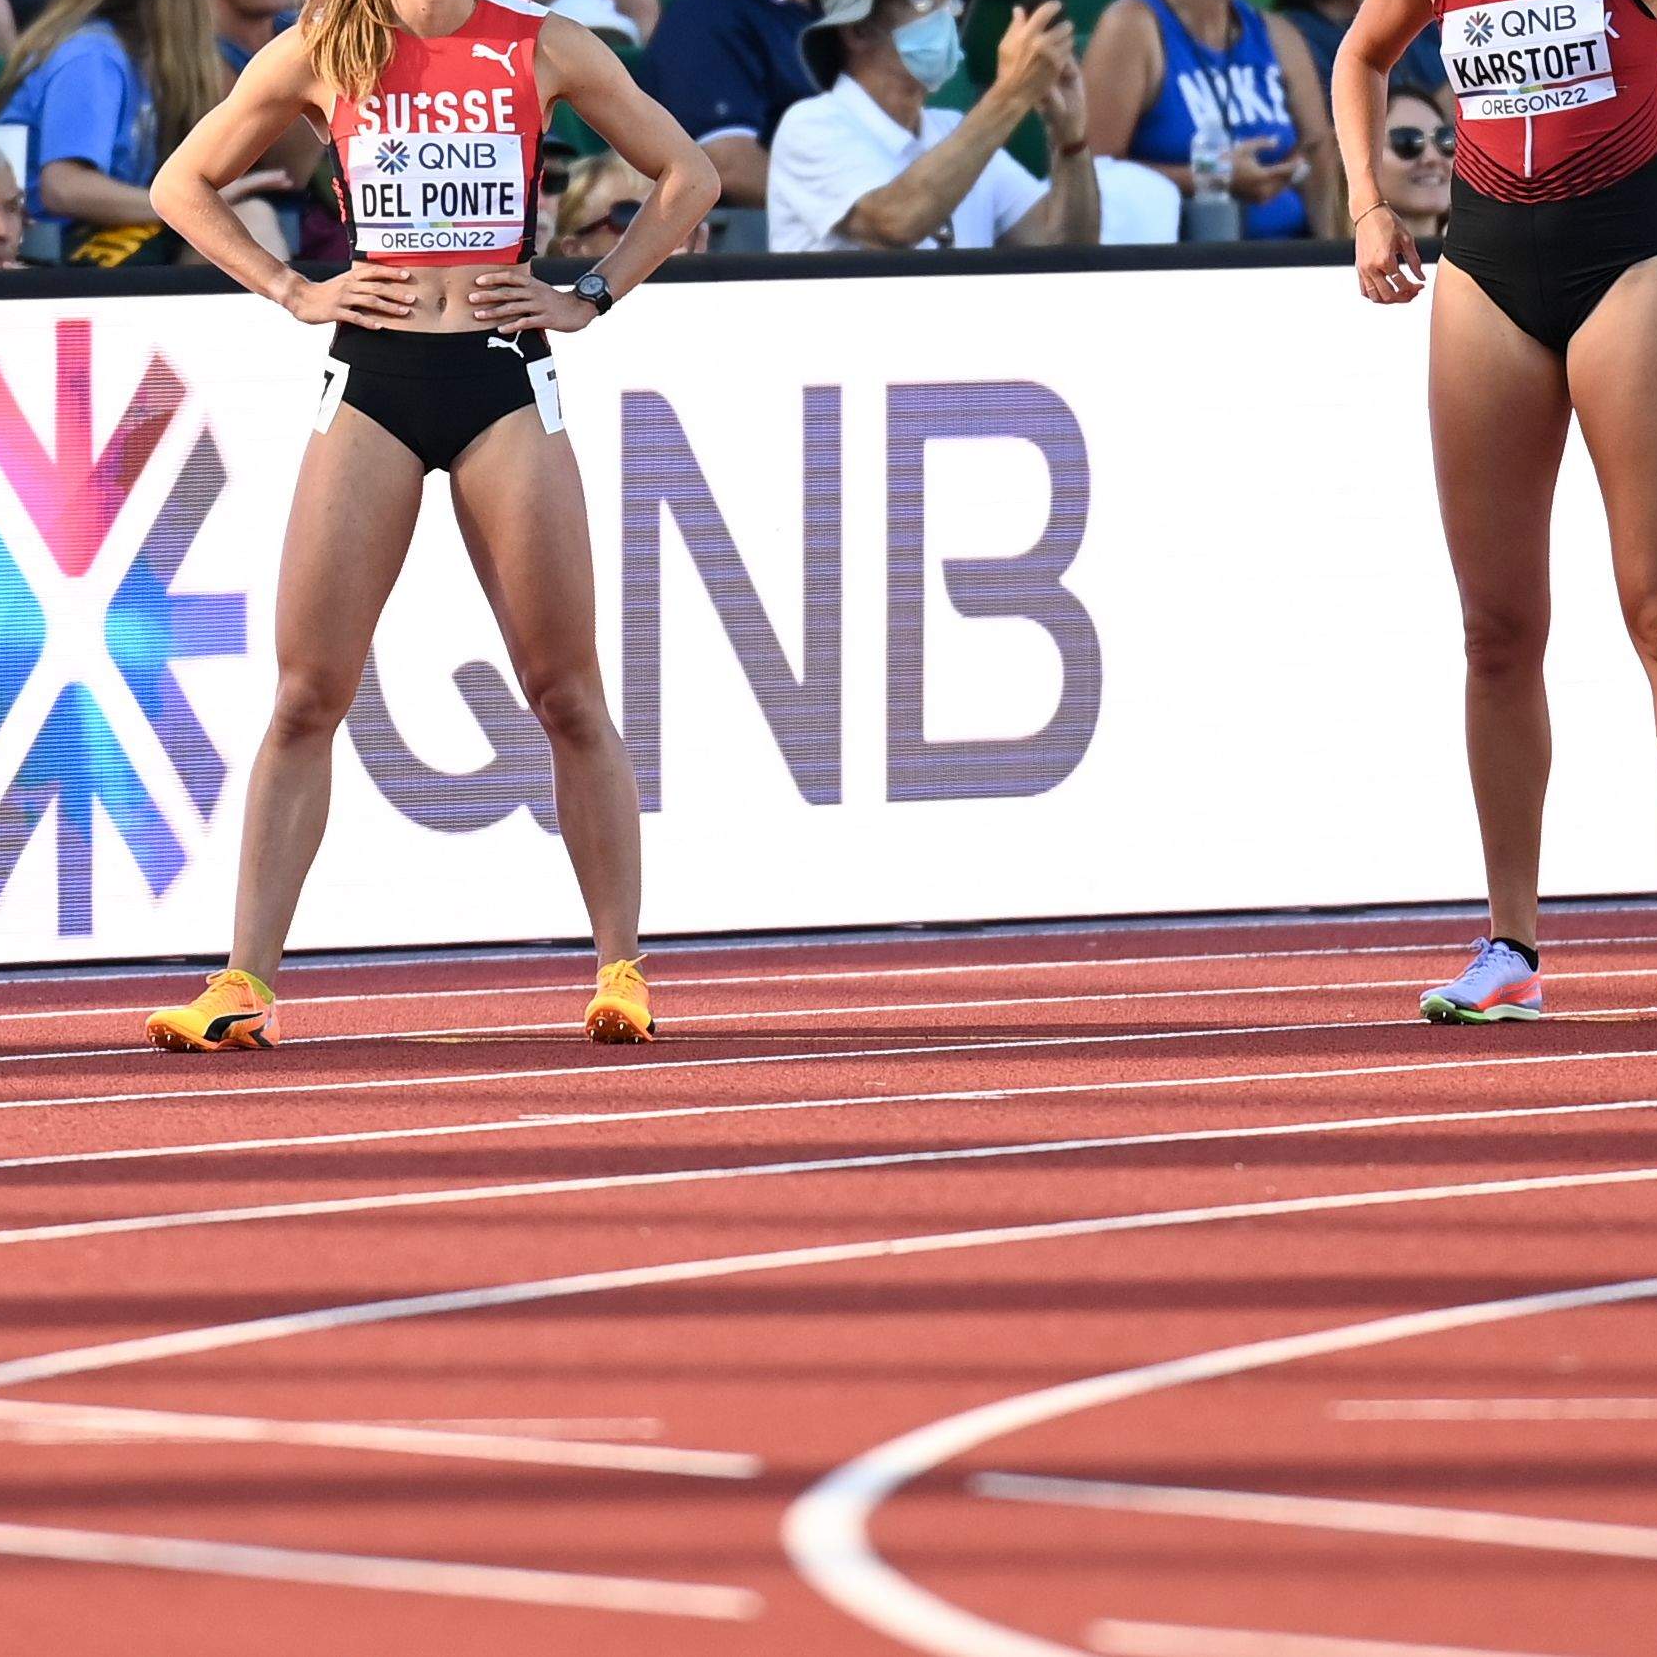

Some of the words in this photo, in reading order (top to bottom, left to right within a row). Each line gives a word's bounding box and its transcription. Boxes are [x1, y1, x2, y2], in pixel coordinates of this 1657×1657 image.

[1500, 4, 1578, 38] QNB
[1452, 39, 1598, 89] KARSTOFT
[1177, 64, 1291, 127] NIKE
[1481, 87, 1588, 116] OREGON22
[418, 142, 497, 170] QNB
[361, 183, 412, 218] DEL
[422, 181, 515, 216] PONTE
[381, 230, 496, 249] OREGON22
